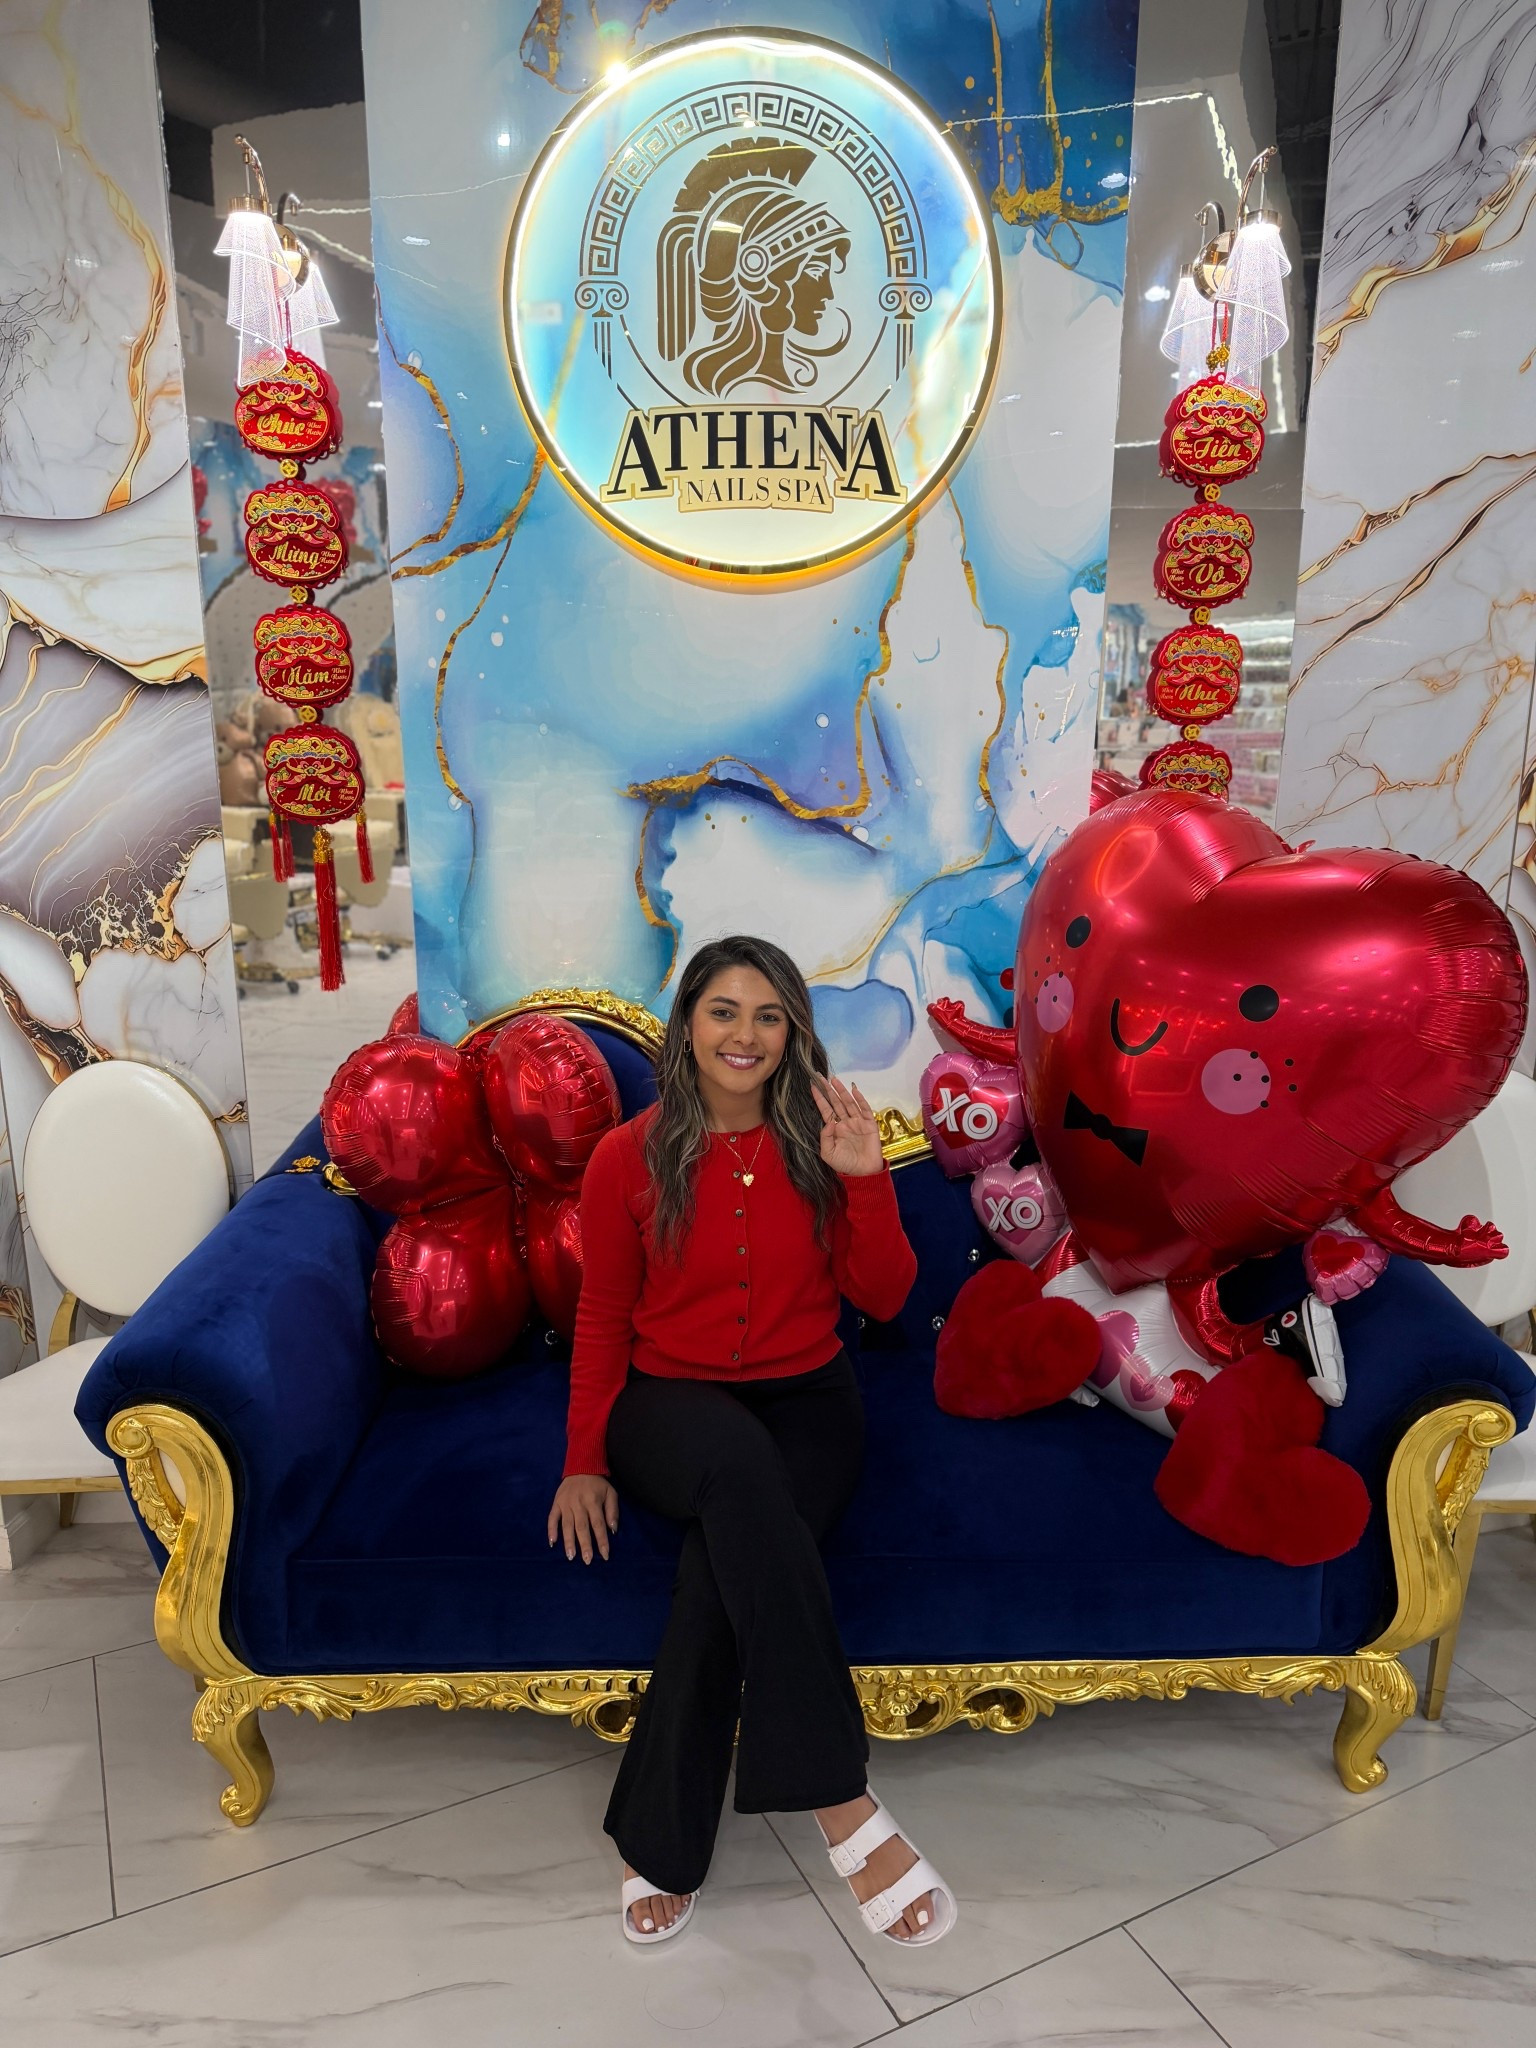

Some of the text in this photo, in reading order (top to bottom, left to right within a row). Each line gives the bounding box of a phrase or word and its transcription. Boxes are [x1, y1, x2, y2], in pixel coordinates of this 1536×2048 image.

[256, 412, 306, 436] Chúc
[606, 410, 901, 497] ATHENA
[1194, 435, 1242, 460] Tiền
[686, 476, 828, 505] NAILS SPA
[1188, 563, 1226, 584] Vô
[282, 665, 332, 686] Năm
[296, 783, 331, 803] Mới
[930, 1087, 998, 1140] XO
[984, 1196, 1042, 1232] XO
